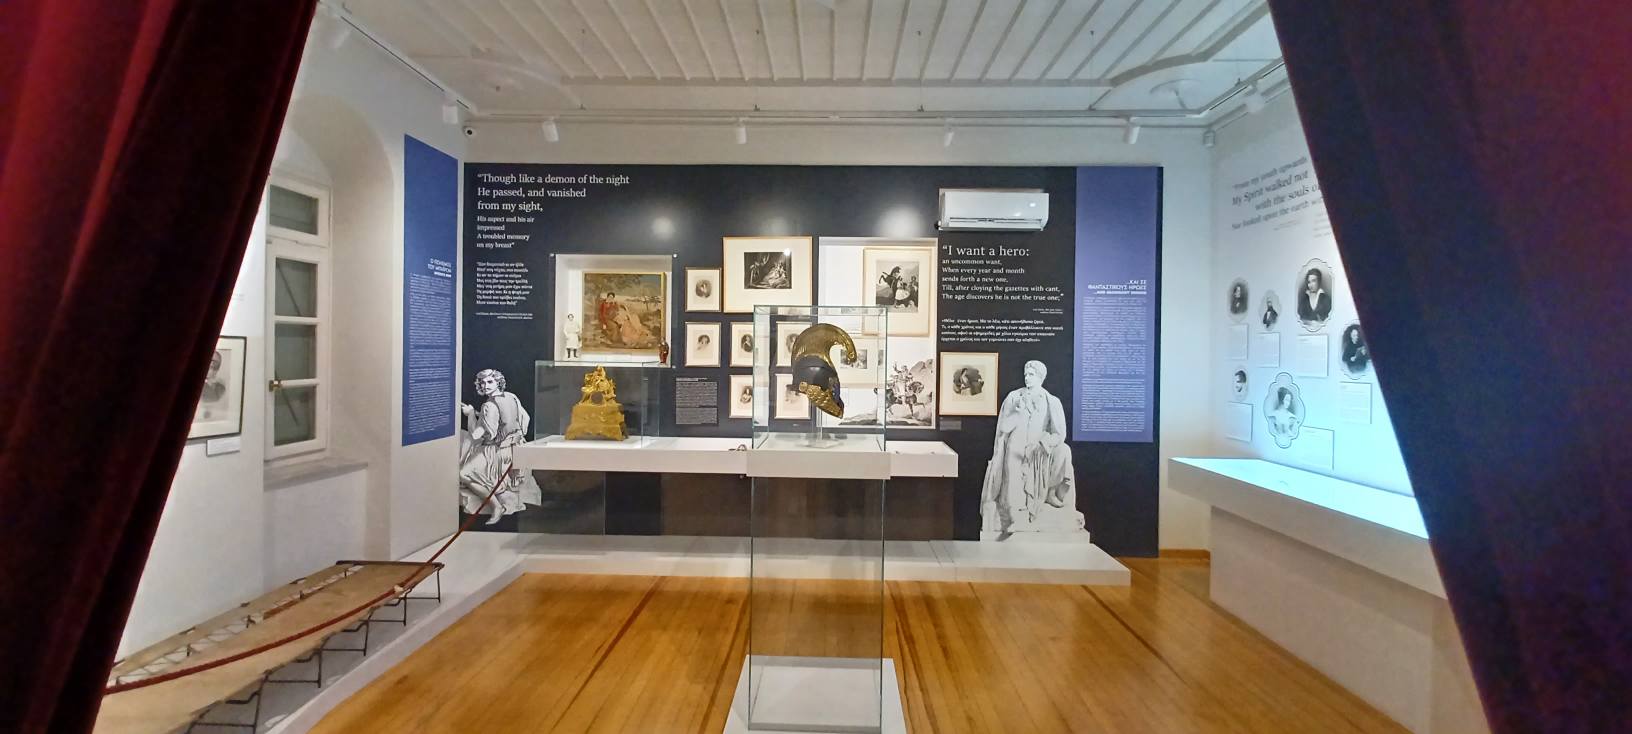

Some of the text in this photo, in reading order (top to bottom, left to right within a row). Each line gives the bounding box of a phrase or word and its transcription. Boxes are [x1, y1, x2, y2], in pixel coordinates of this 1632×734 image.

[519, 173, 536, 183] like
[544, 174, 576, 184] demon
[578, 174, 588, 184] of
[589, 174, 604, 184] the
[606, 174, 630, 186] night
[478, 187, 586, 198] He passed, and vanished
[1288, 185, 1310, 199] souls
[477, 200, 543, 212] from my sight,
[942, 244, 1030, 257] “I want a hero:
